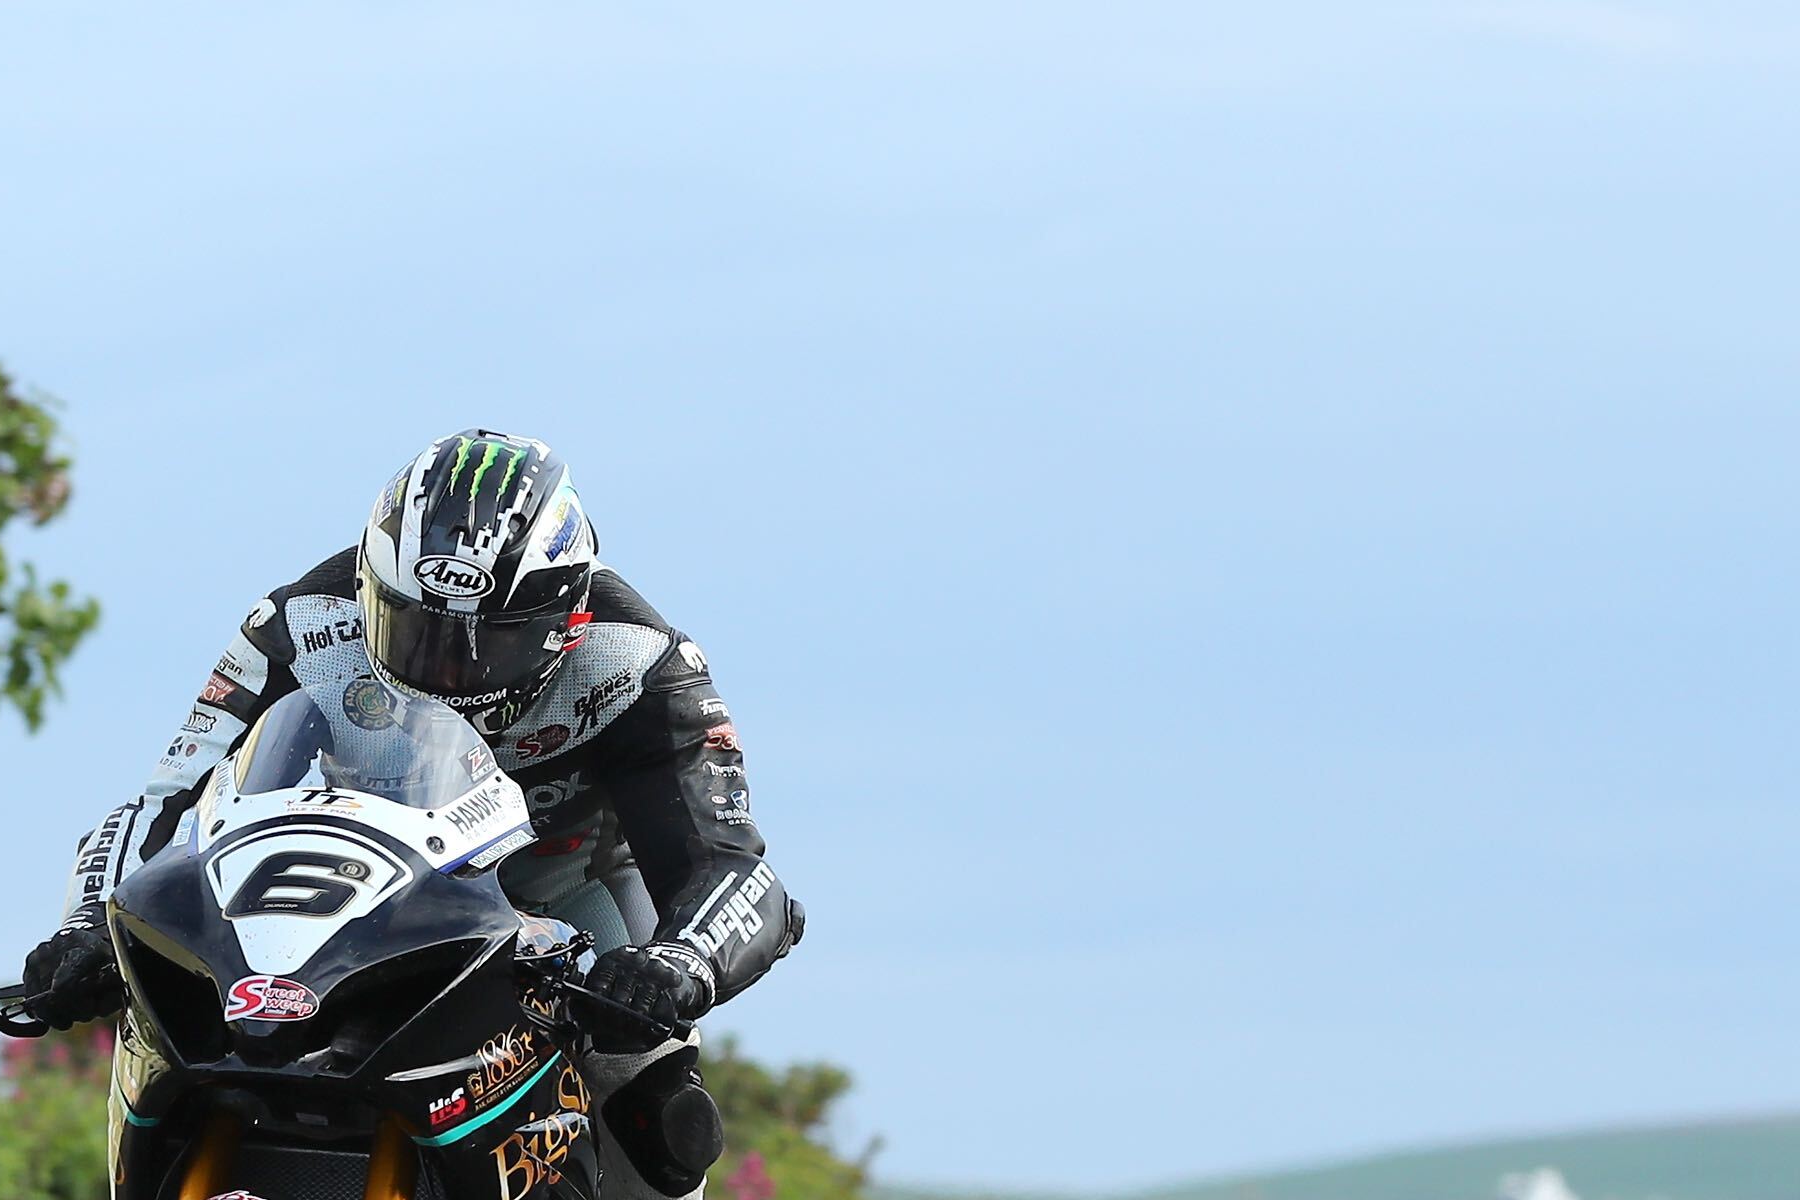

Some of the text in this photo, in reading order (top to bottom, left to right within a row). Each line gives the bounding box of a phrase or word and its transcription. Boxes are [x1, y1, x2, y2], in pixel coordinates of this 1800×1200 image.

[419, 560, 484, 591] Arai
[300, 789, 356, 805] TT
[223, 851, 373, 918] 6
[677, 861, 776, 958] Furygan
